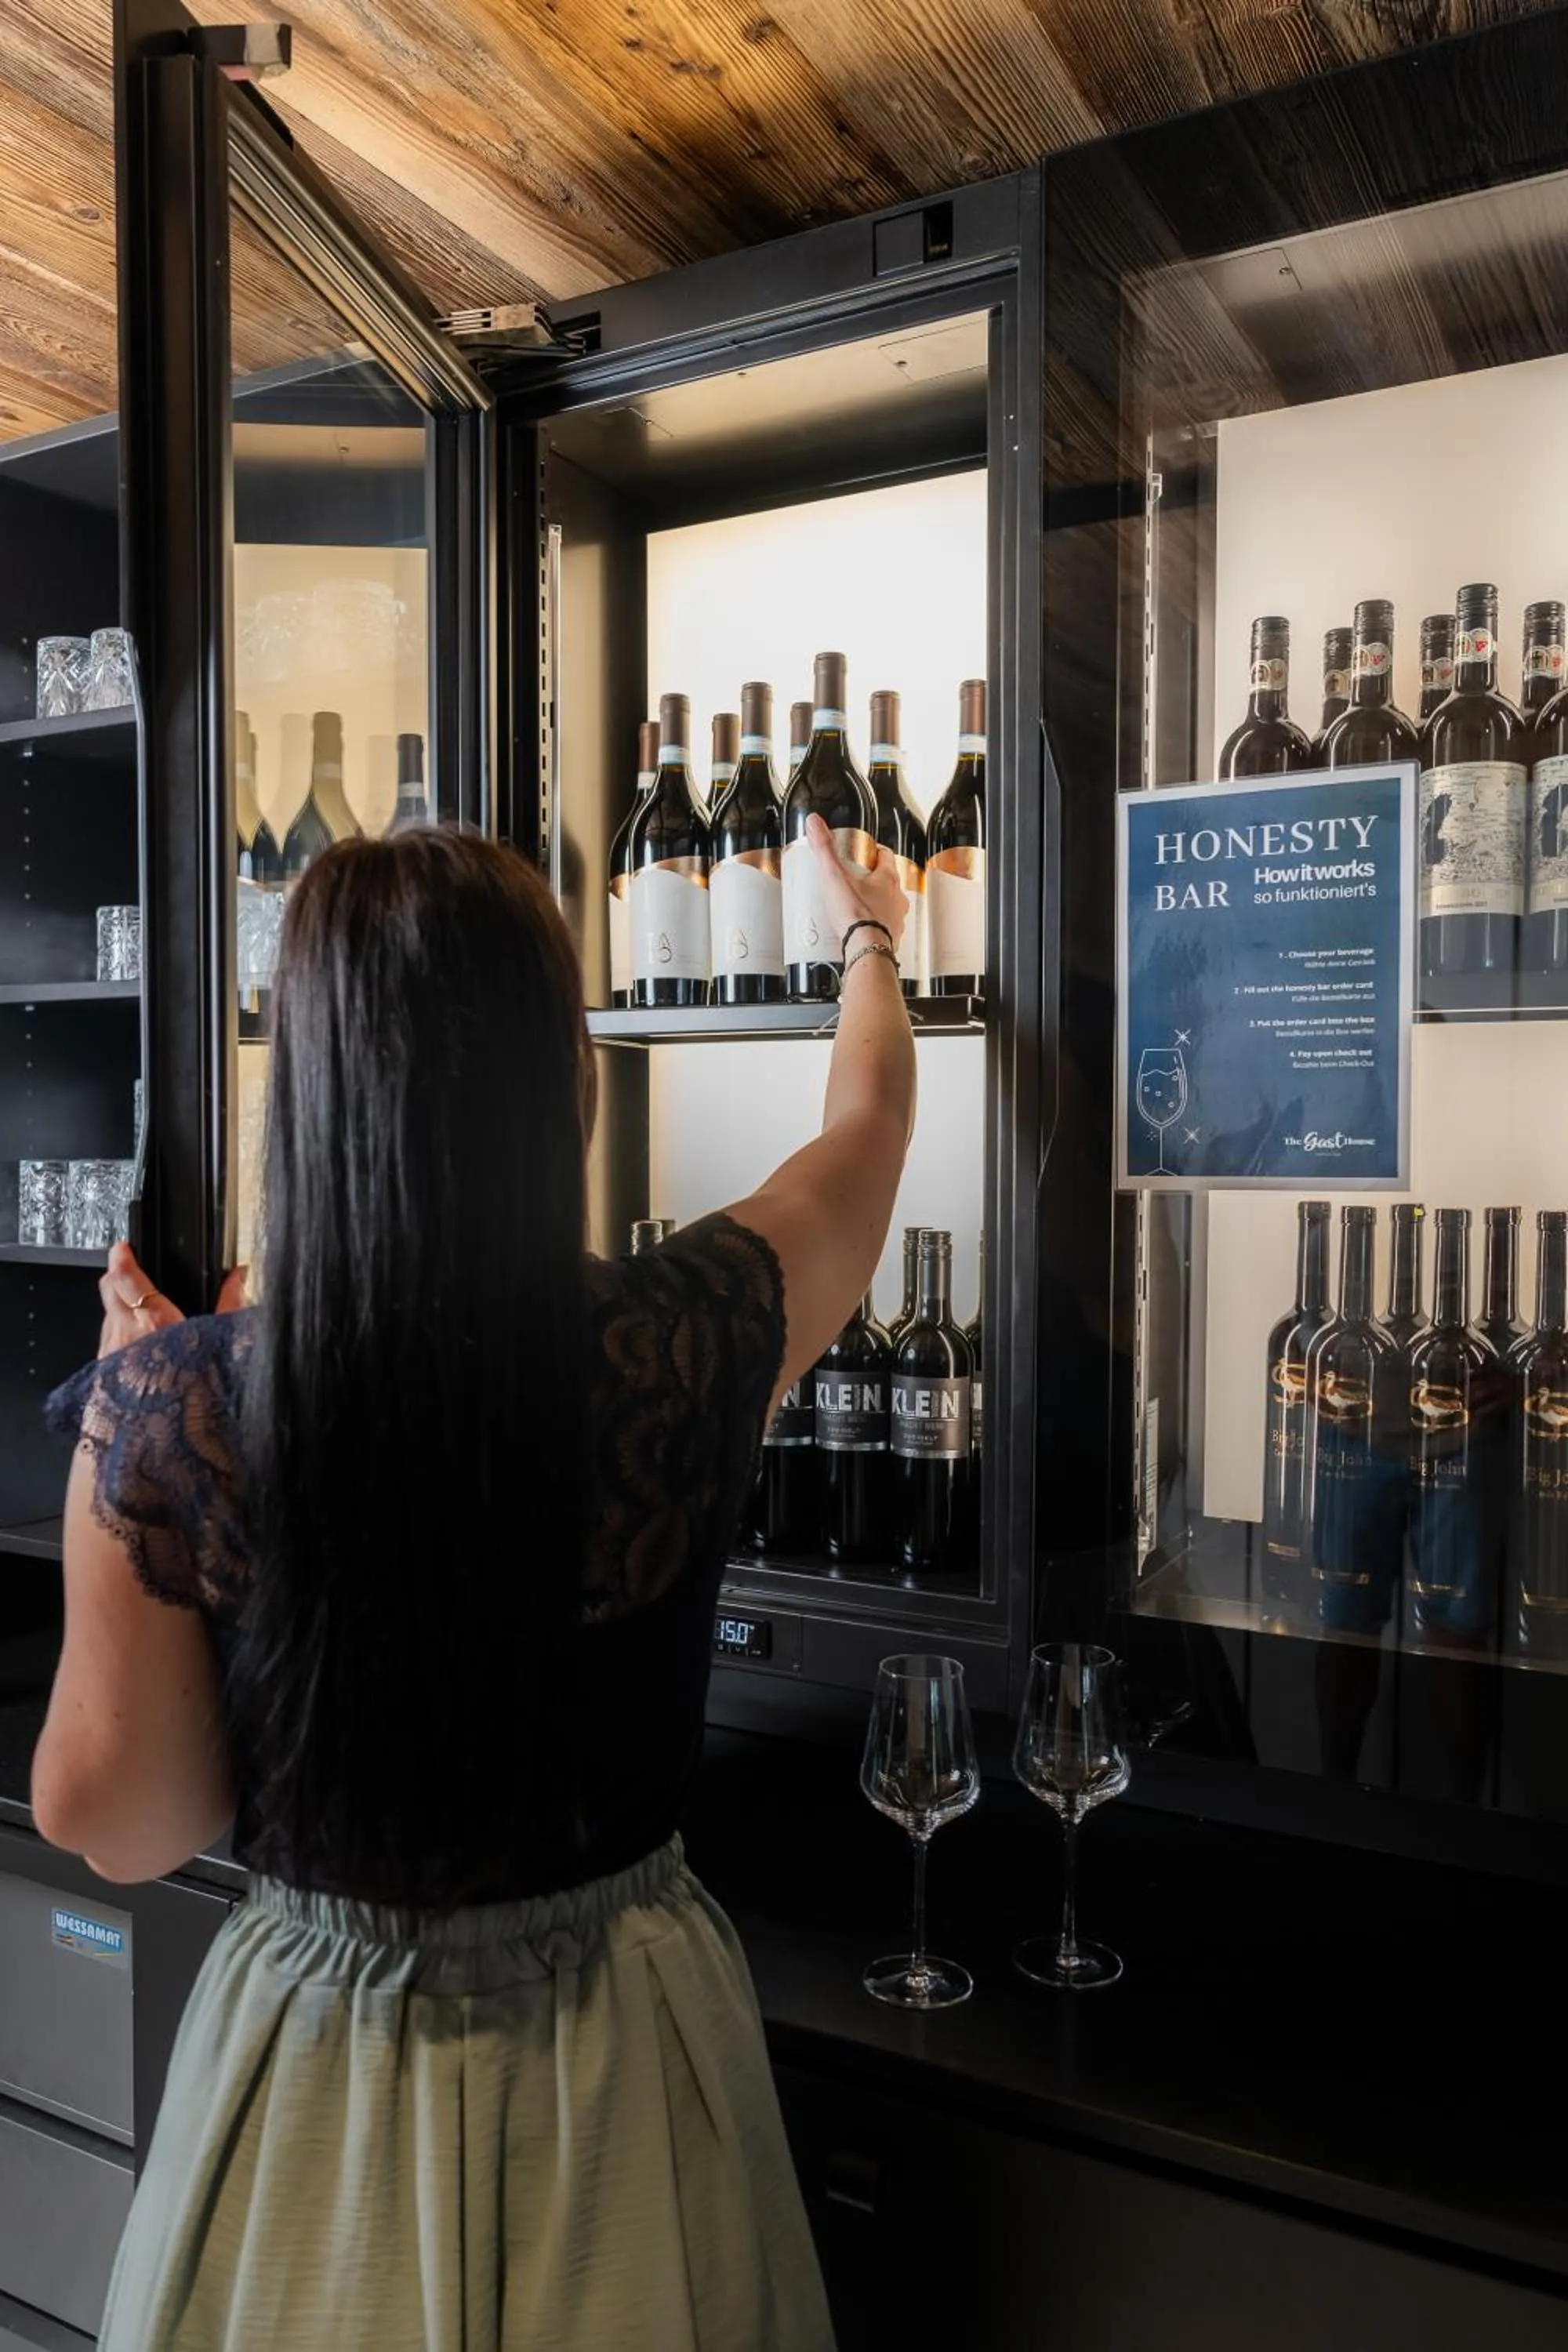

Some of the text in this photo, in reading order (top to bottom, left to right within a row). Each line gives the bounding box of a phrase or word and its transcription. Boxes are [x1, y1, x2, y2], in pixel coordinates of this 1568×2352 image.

[1154, 815, 1378, 865] HONESTY
[1154, 880, 1231, 912] BAR
[1254, 883, 1377, 904] so funktioniert's
[1304, 1131, 1345, 1152] Gast
[815, 1381, 881, 1412] KLEIN
[891, 1386, 960, 1419] KLEIN
[55, 1912, 121, 1948] WESSAMAT
